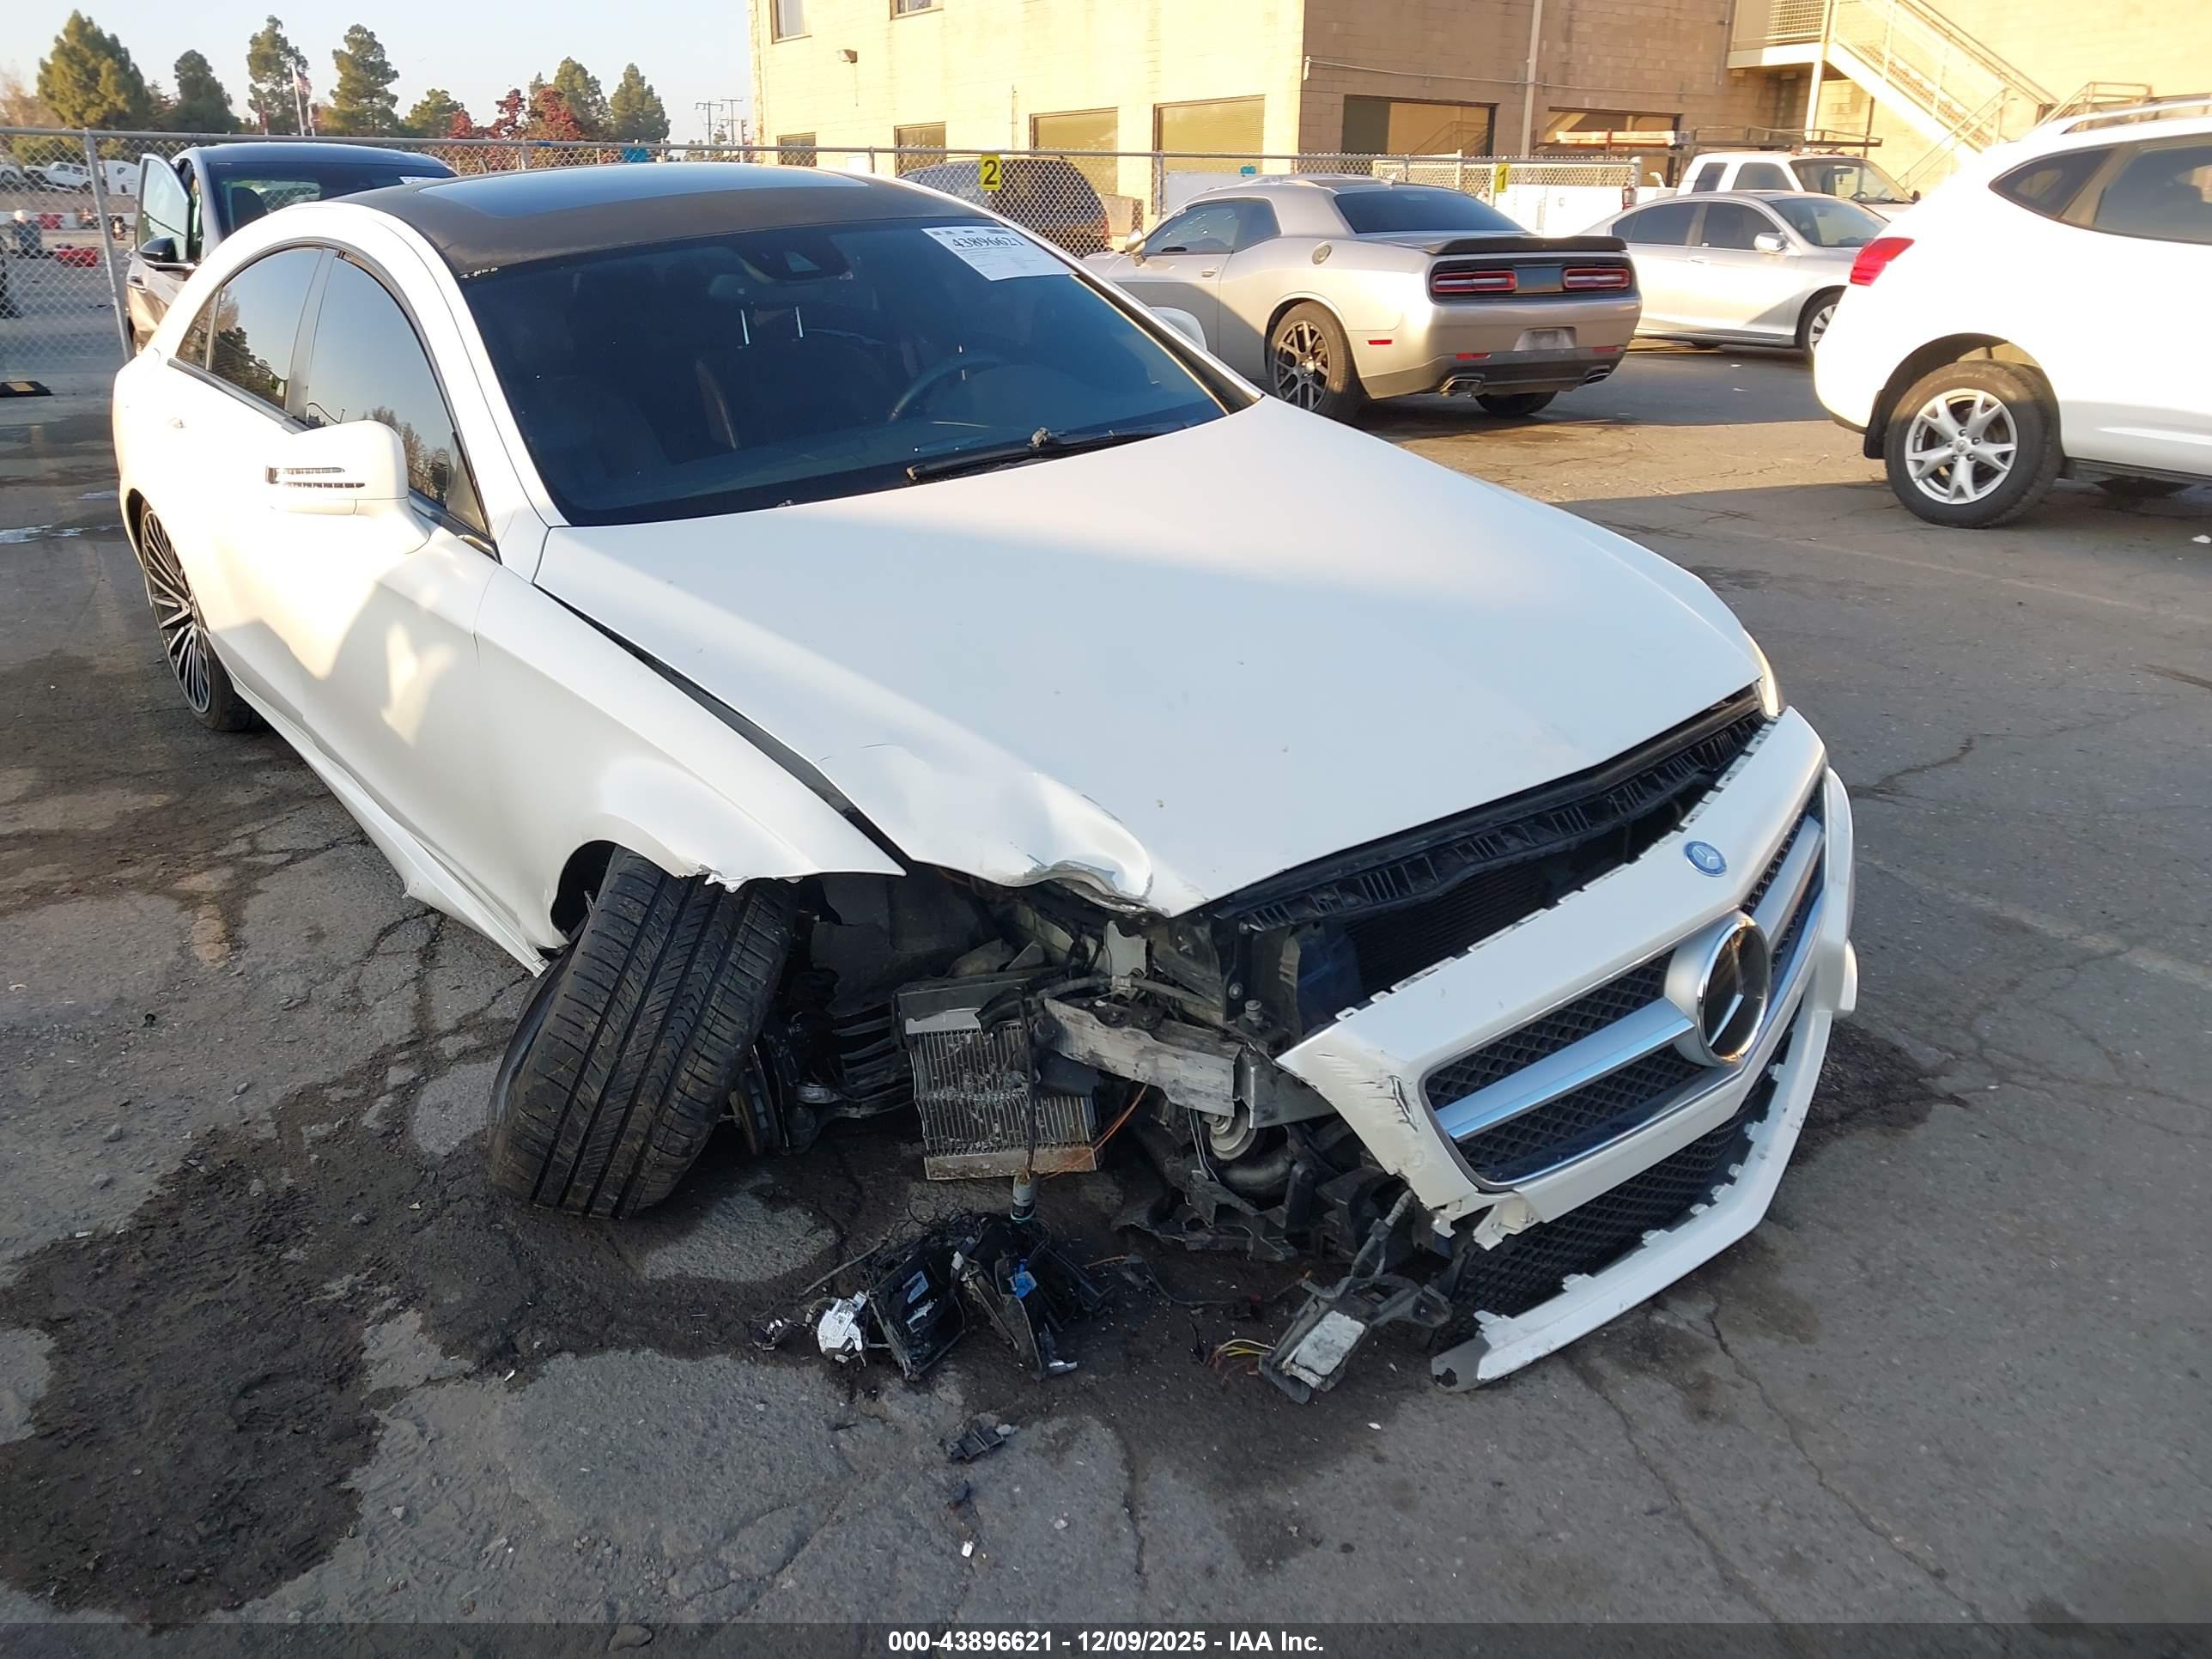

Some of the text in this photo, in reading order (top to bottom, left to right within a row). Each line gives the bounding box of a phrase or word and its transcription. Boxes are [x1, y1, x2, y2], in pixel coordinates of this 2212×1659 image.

[983, 159, 998, 185] 2
[1498, 167, 1507, 189] 1
[952, 236, 1024, 248] 43896621
